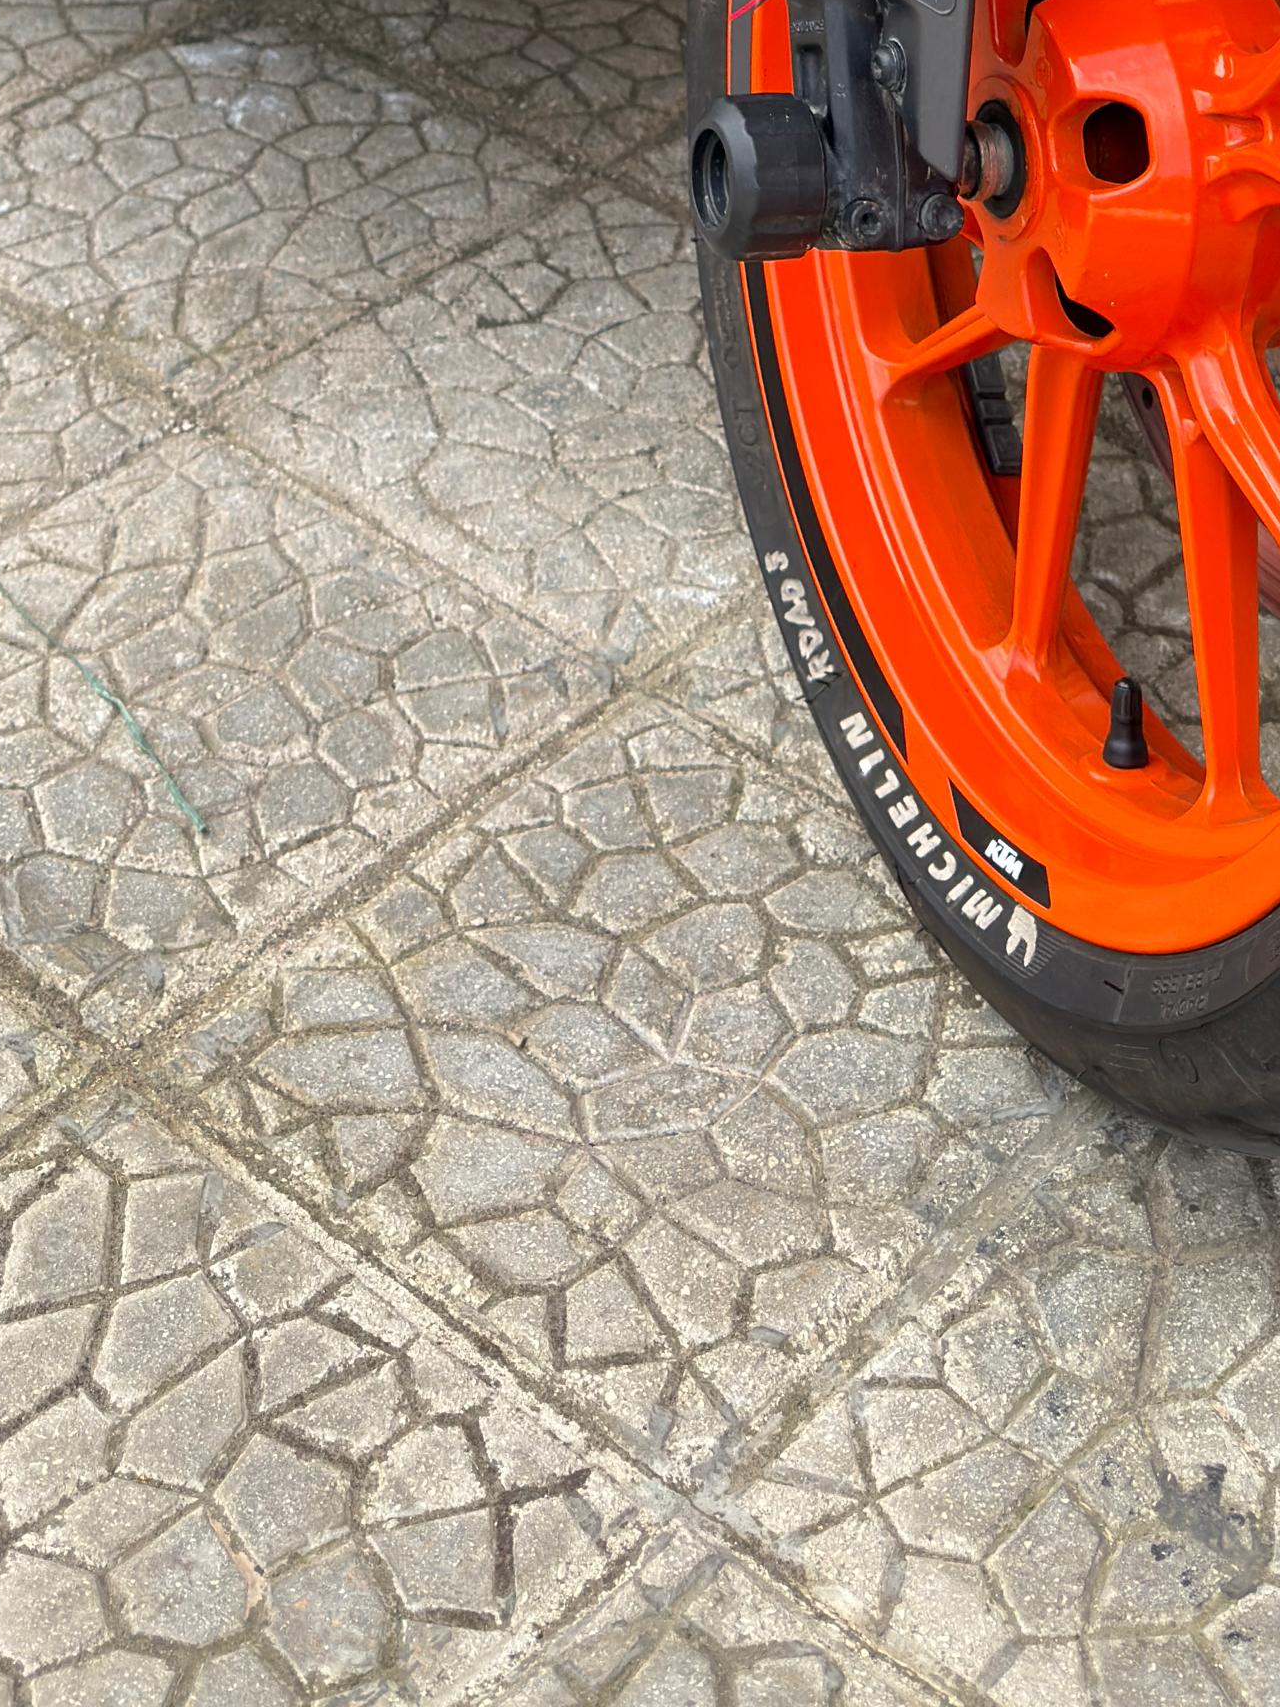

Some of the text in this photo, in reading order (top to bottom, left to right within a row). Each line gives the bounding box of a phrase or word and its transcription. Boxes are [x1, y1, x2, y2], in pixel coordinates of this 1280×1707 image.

[780, 577, 836, 683] ROAD
[839, 711, 1003, 931] MICHELIN
[983, 836, 1024, 883] KTM
